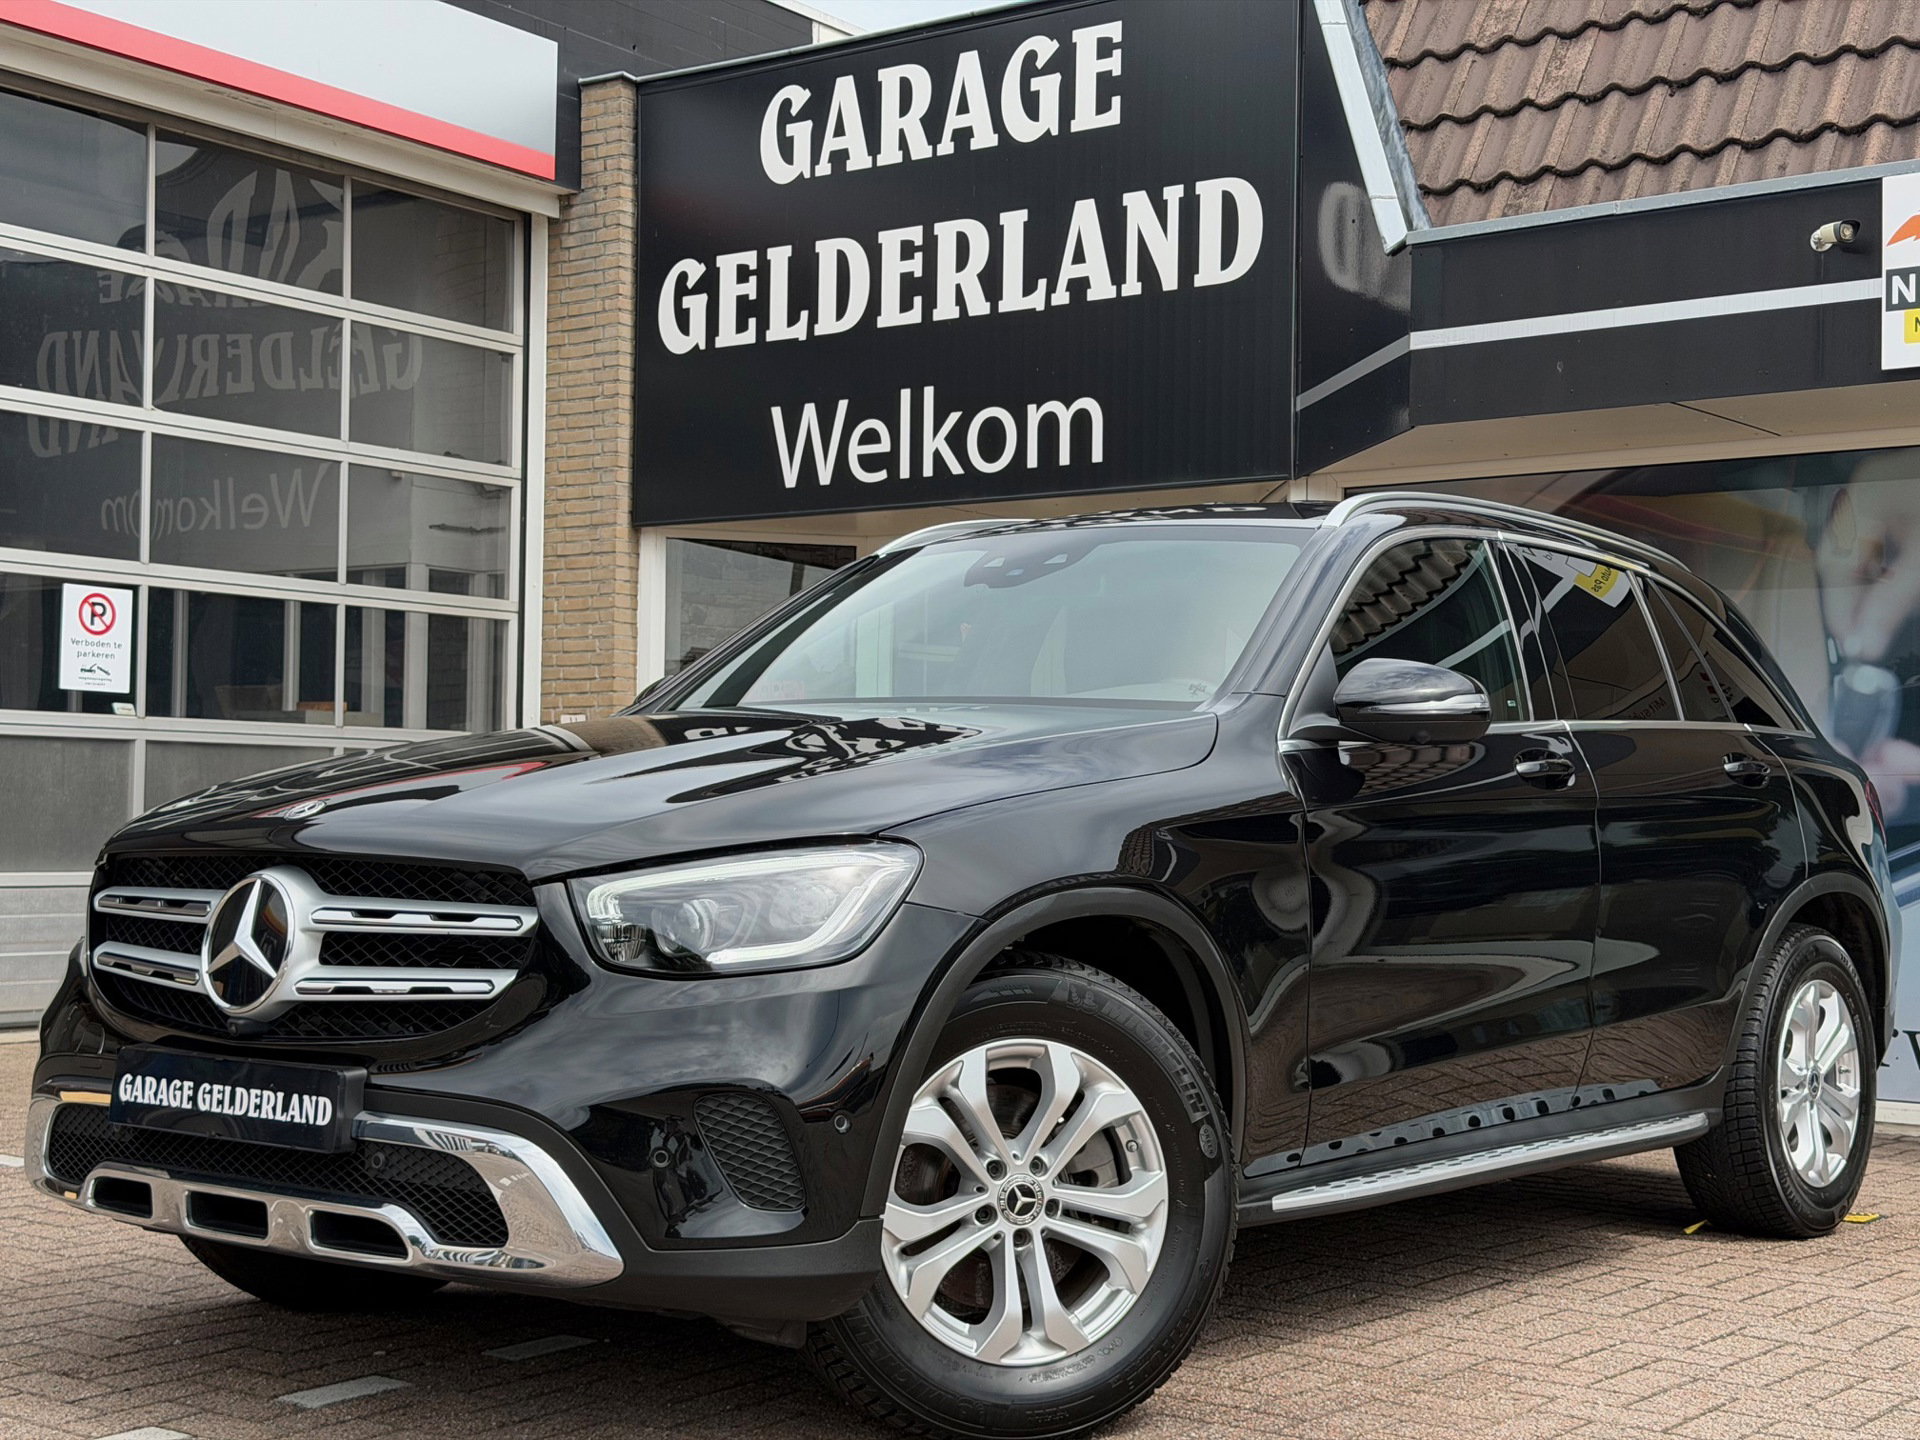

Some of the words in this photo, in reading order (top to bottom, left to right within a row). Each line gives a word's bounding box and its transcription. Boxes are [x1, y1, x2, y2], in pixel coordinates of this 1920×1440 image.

[759, 20, 1123, 185] GARAGE
[657, 176, 1264, 355] GELDERLAND
[770, 385, 1105, 489] Welkom
[70, 637, 111, 648] Verboden
[114, 641, 123, 649] te
[77, 650, 116, 660] parkeren
[118, 1073, 194, 1110] GARAGE
[197, 1082, 333, 1127] GELDERLAND
